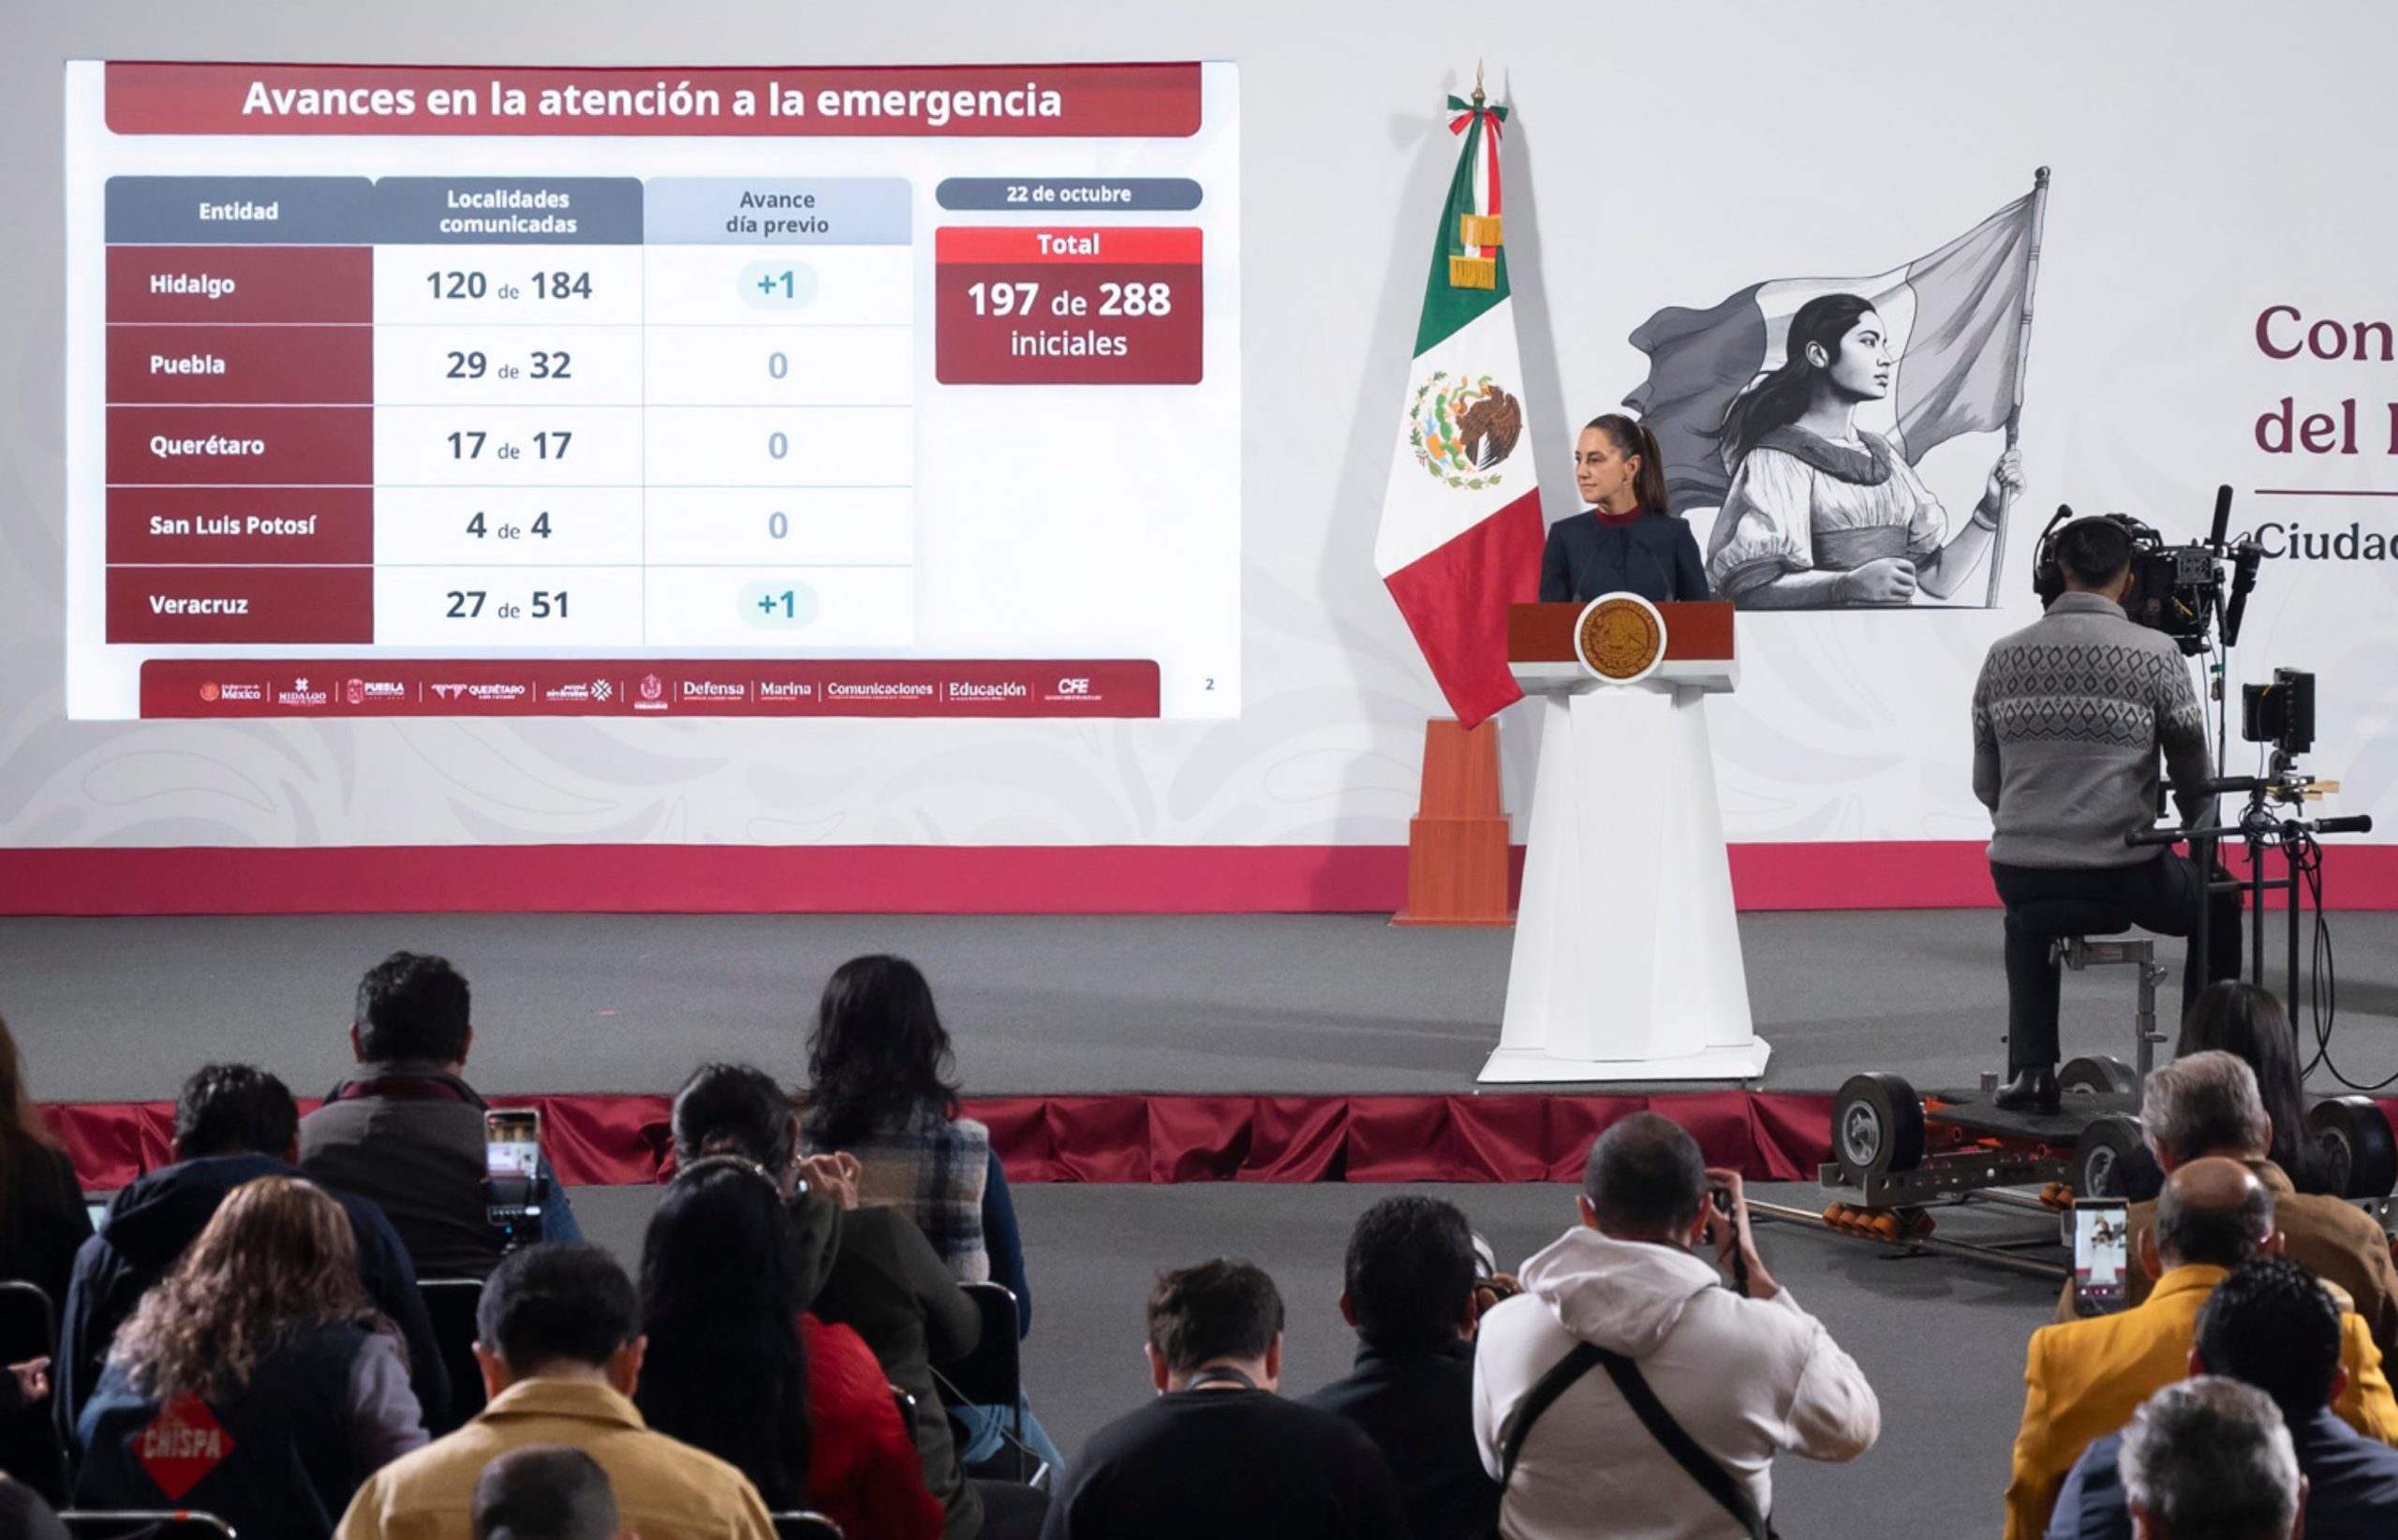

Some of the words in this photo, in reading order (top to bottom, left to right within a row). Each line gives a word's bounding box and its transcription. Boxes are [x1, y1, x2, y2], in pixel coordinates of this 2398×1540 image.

[243, 81, 415, 115] Avances
[427, 89, 476, 115] en
[492, 81, 525, 115] la
[539, 81, 718, 115] atención
[733, 90, 755, 115] a
[770, 82, 804, 115] la
[818, 82, 1061, 126] emergencia
[447, 189, 570, 208] Localidades
[739, 190, 816, 208] Avance
[1007, 186, 1028, 202] 22
[1033, 185, 1056, 202] de
[1060, 185, 1132, 202] octubre
[199, 201, 279, 220] Entidad
[439, 215, 578, 233] comunicadas
[726, 216, 758, 233] día
[763, 216, 829, 238] previo
[1037, 232, 1100, 255] Total
[150, 274, 236, 299] Hidalgo
[426, 272, 487, 299] 120
[498, 284, 520, 299] de
[531, 272, 593, 299] 184
[758, 272, 793, 298] +1
[969, 283, 1040, 316] 197
[1052, 289, 1088, 316] de
[1099, 283, 1172, 316] 288
[1012, 329, 1128, 356] iniciales
[150, 355, 226, 375] Puebla
[446, 351, 487, 378] 29
[498, 364, 520, 379] de
[530, 351, 571, 378] 32
[768, 352, 788, 378] 0
[2255, 395, 2359, 455] del
[150, 435, 265, 458] Querétaro
[447, 432, 487, 459] 17
[498, 443, 521, 459] de
[532, 432, 572, 459] 17
[768, 432, 789, 459] 0
[150, 515, 190, 535] San
[196, 514, 241, 535] Luis
[246, 514, 318, 535] Potosí
[466, 511, 488, 539] 4
[498, 524, 521, 540] de
[530, 511, 553, 539] 4
[768, 511, 789, 539] 0
[150, 595, 248, 615] Veracruz
[446, 591, 487, 618] 27
[498, 602, 521, 618] de
[531, 591, 568, 618] 51
[758, 591, 794, 617] +1
[221, 688, 261, 700] México
[364, 682, 405, 692] PUEBLA
[468, 684, 525, 695] QUERÉTARO
[683, 681, 745, 695] Defensa
[761, 681, 811, 695] Marina
[827, 682, 933, 695] Comunicaciones
[949, 681, 1027, 696] Educación
[1058, 678, 1089, 694] CFE
[1205, 678, 1216, 691] 2
[278, 691, 327, 701] HIDALGO
[144, 1429, 222, 1459] CHISPA
